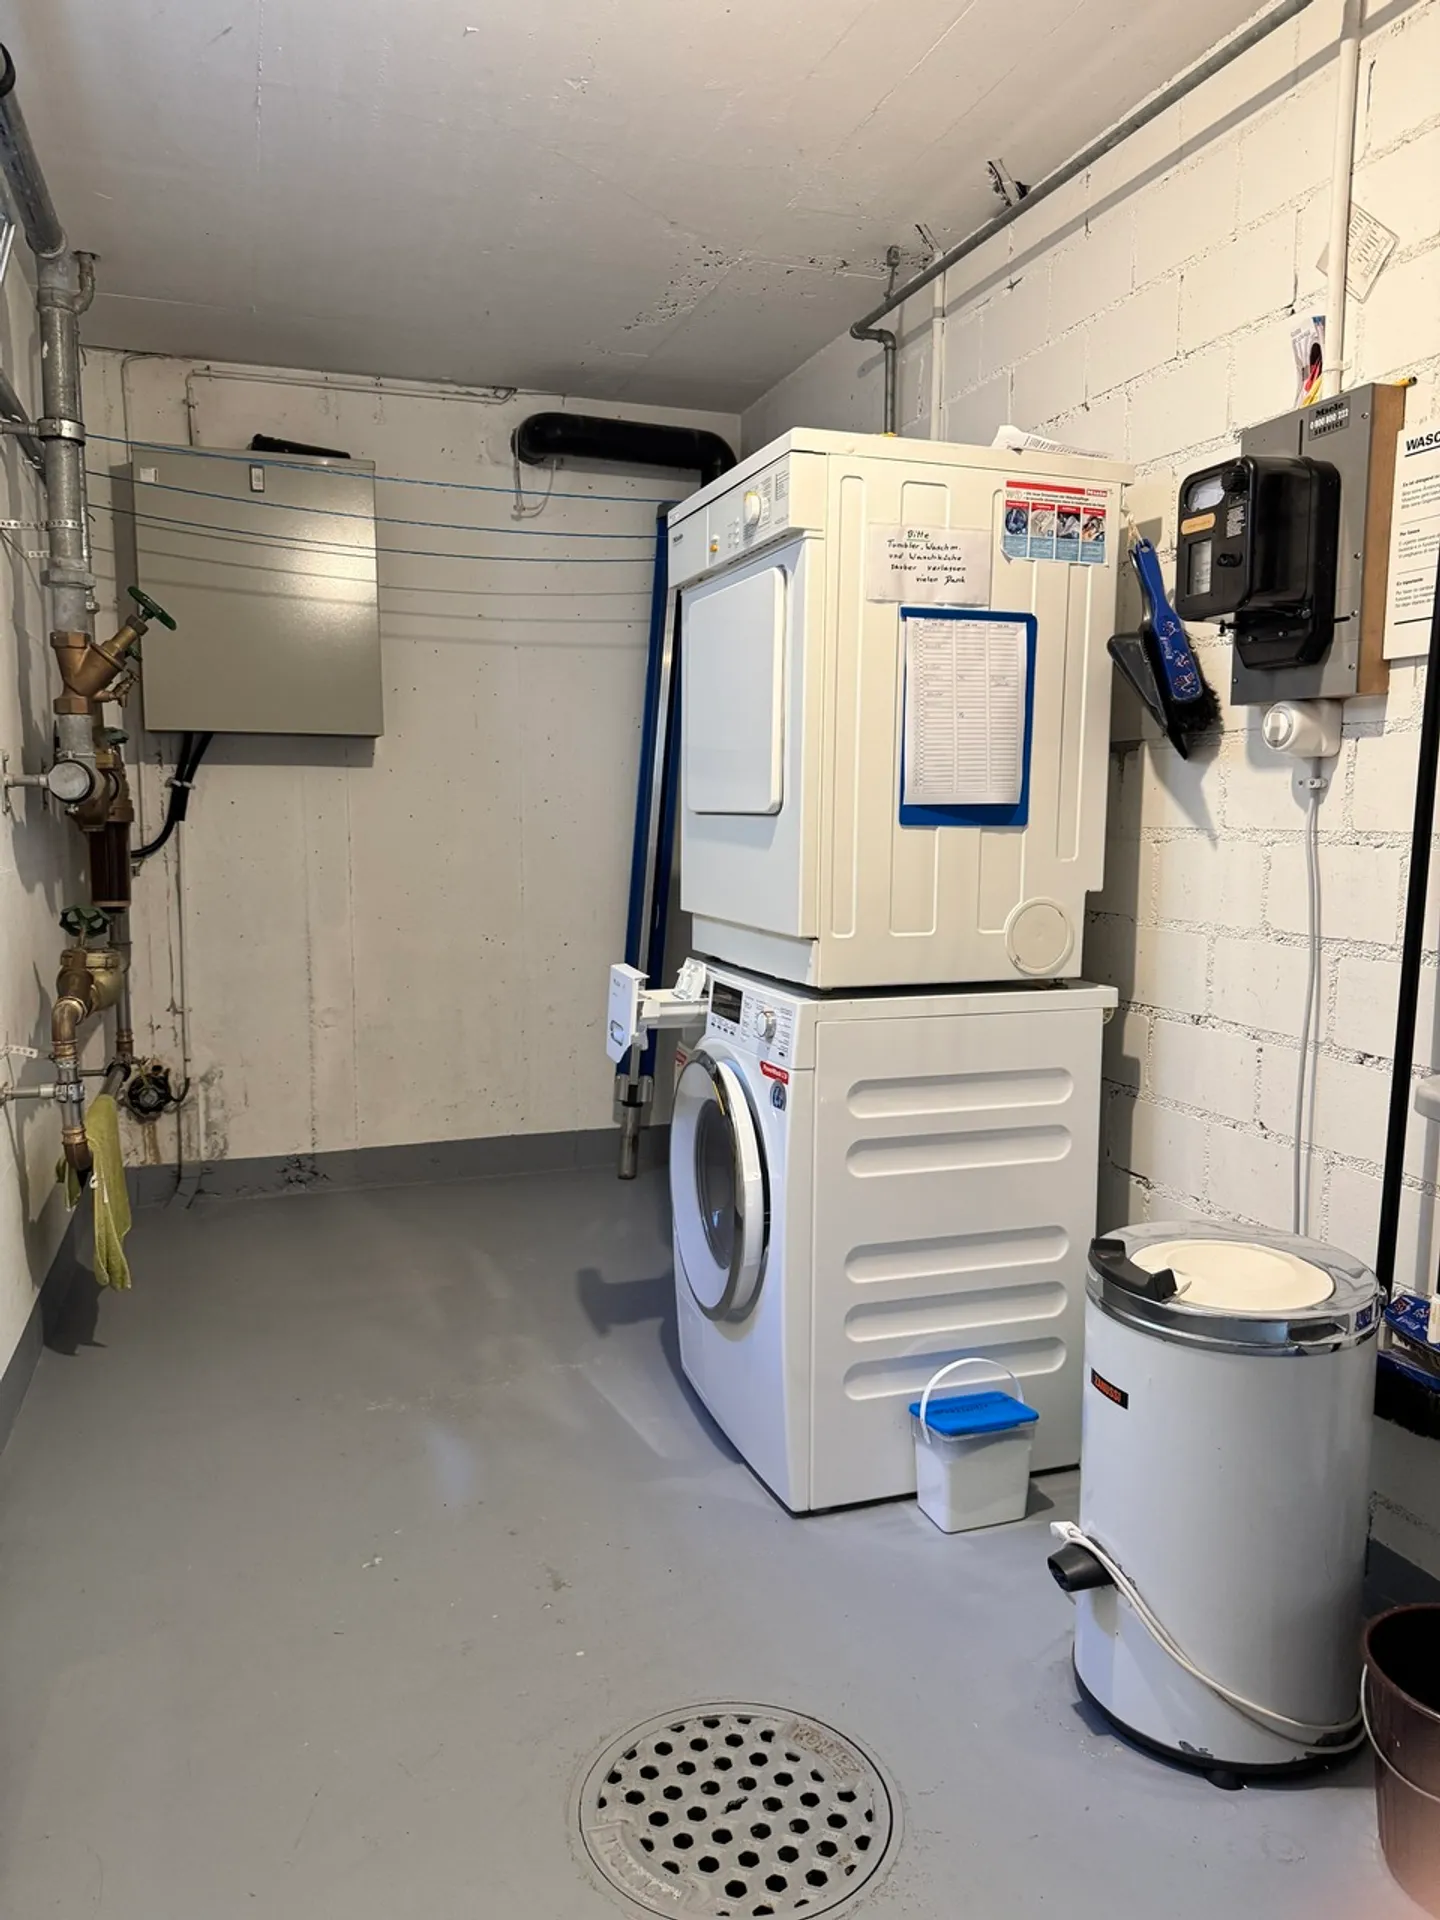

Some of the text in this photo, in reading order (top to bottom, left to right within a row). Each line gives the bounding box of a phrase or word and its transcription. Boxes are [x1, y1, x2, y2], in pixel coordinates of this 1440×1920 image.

[1316, 402, 1344, 418] Miele
[1314, 420, 1343, 436] SERVICE
[907, 529, 929, 539] Bitte
[944, 575, 965, 586] Dank
